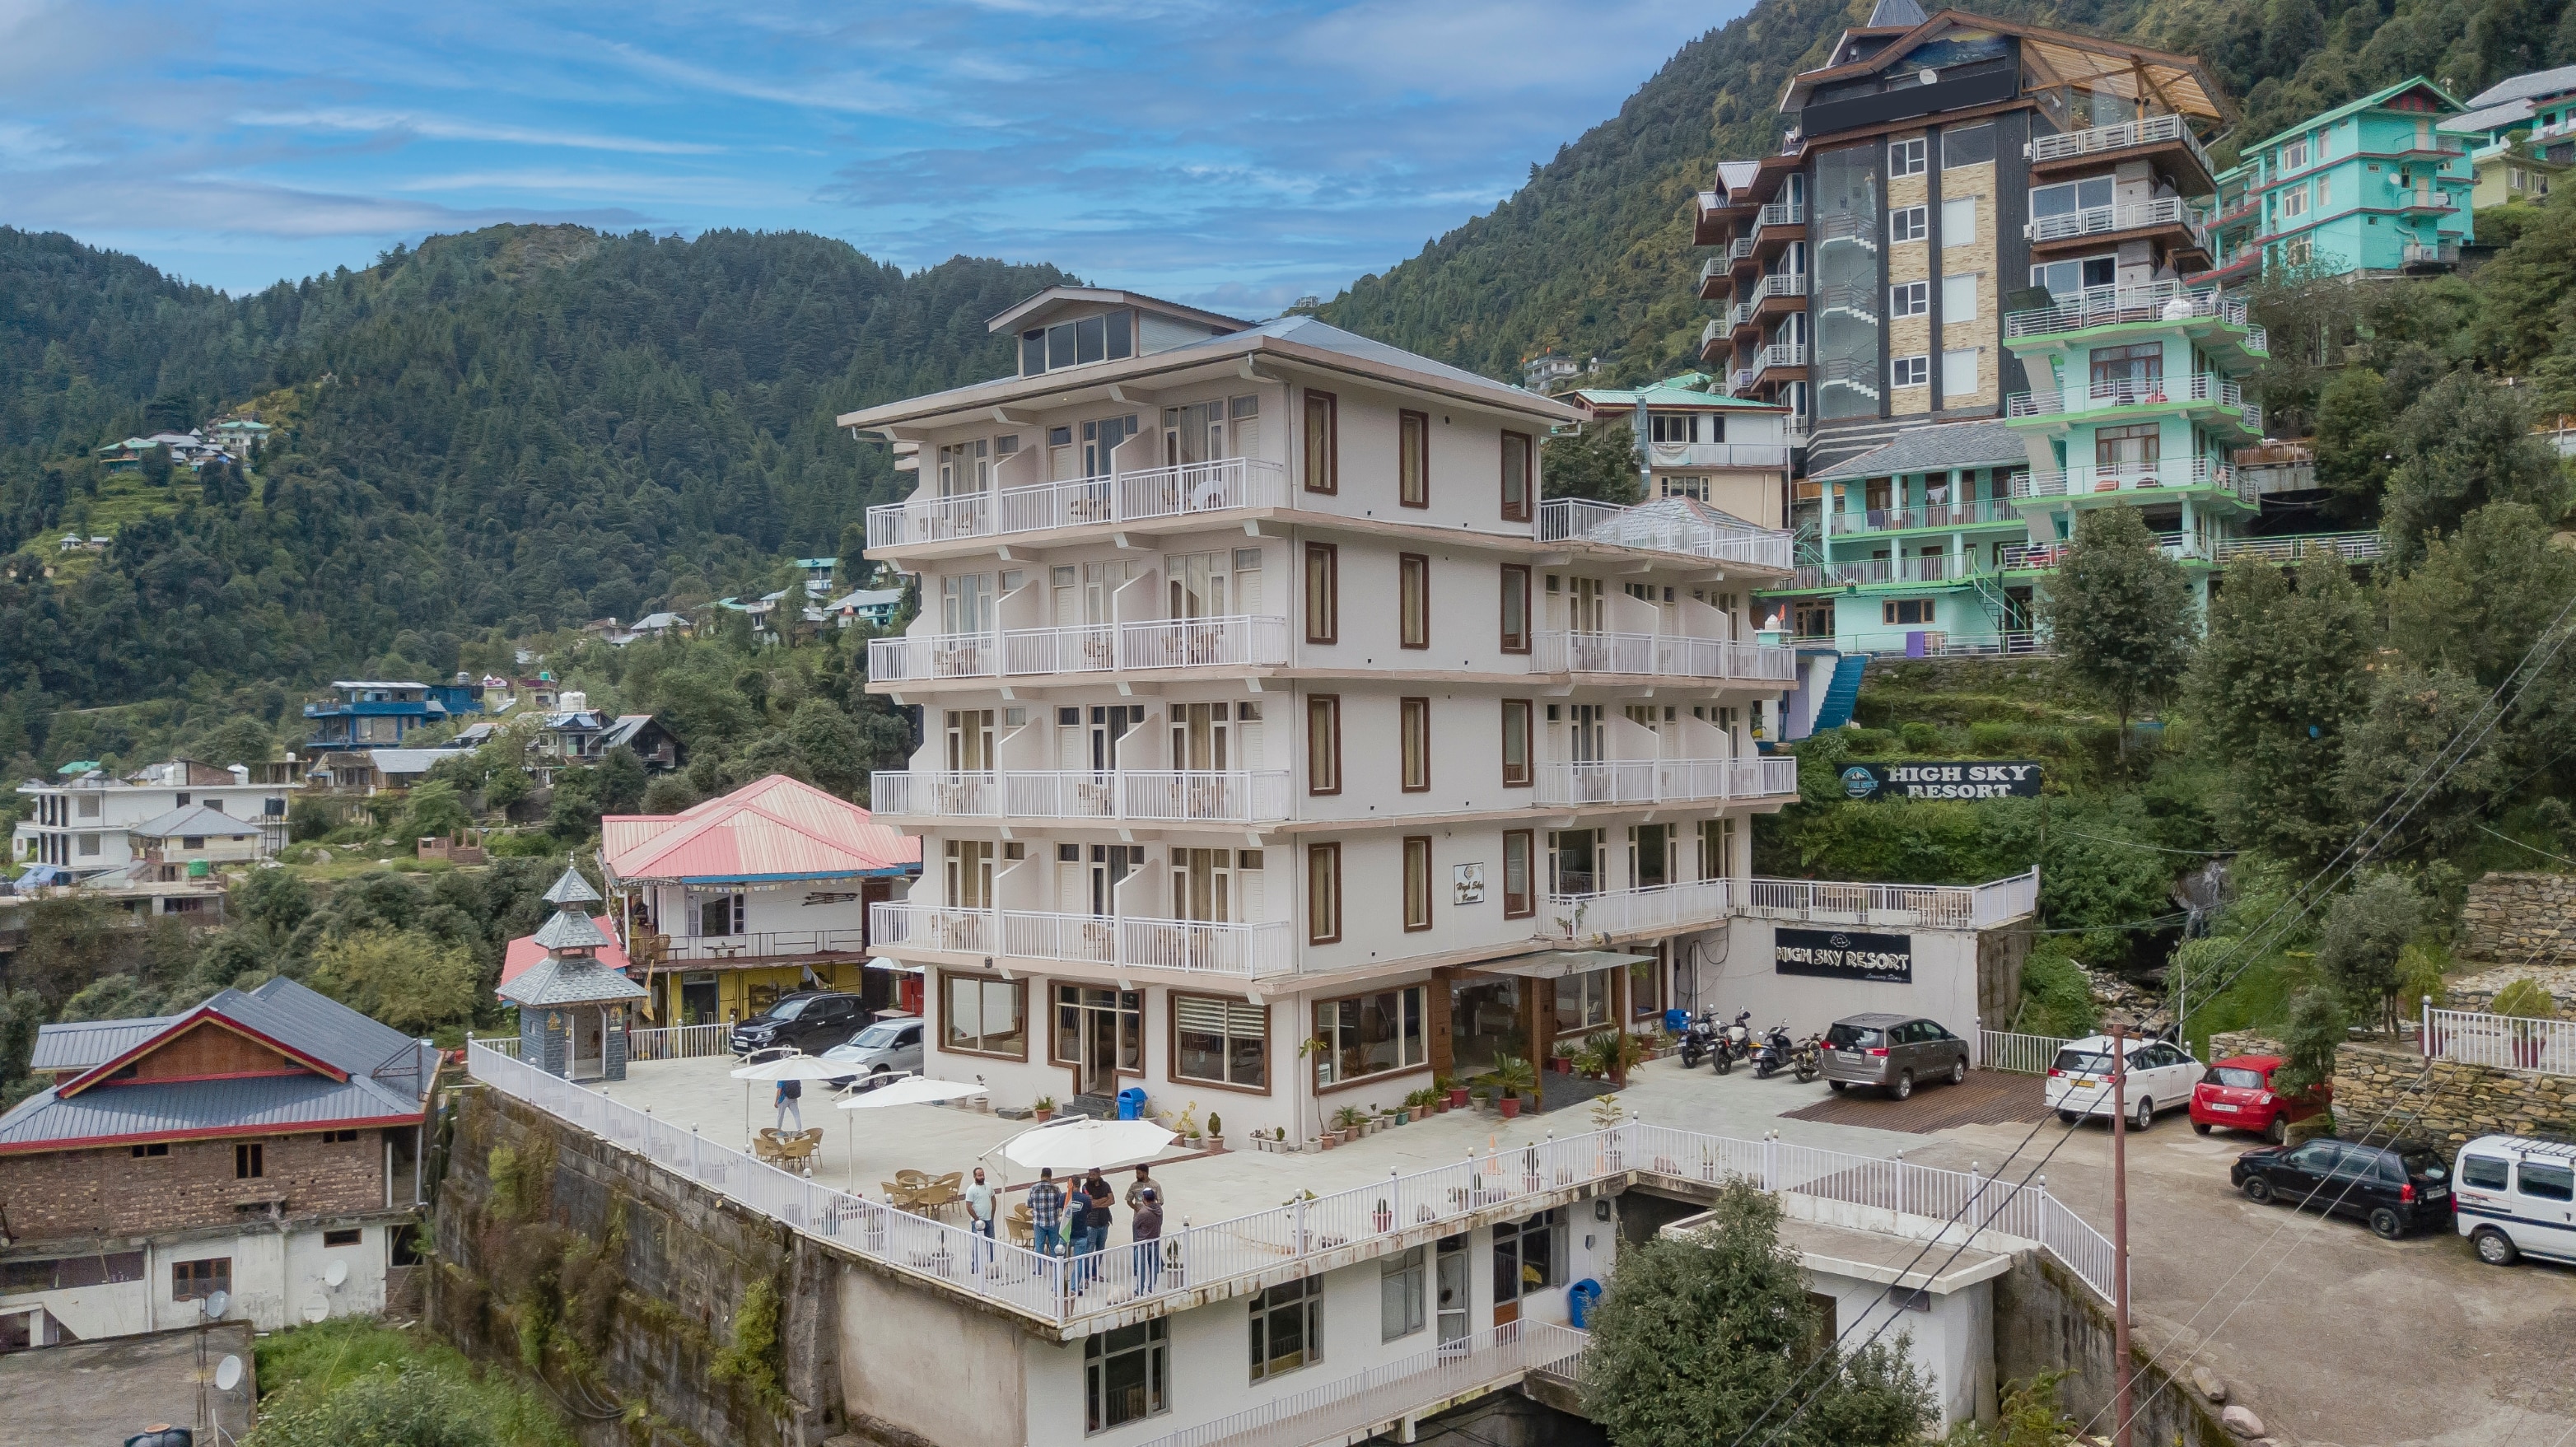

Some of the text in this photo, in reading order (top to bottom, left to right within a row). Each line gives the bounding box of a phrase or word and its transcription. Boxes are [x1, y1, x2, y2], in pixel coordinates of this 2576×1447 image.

[1888, 766, 2031, 782] HIGH SKY
[1907, 784, 2012, 799] RESORT
[1776, 946, 1910, 971] HIGH SKY RESORT
